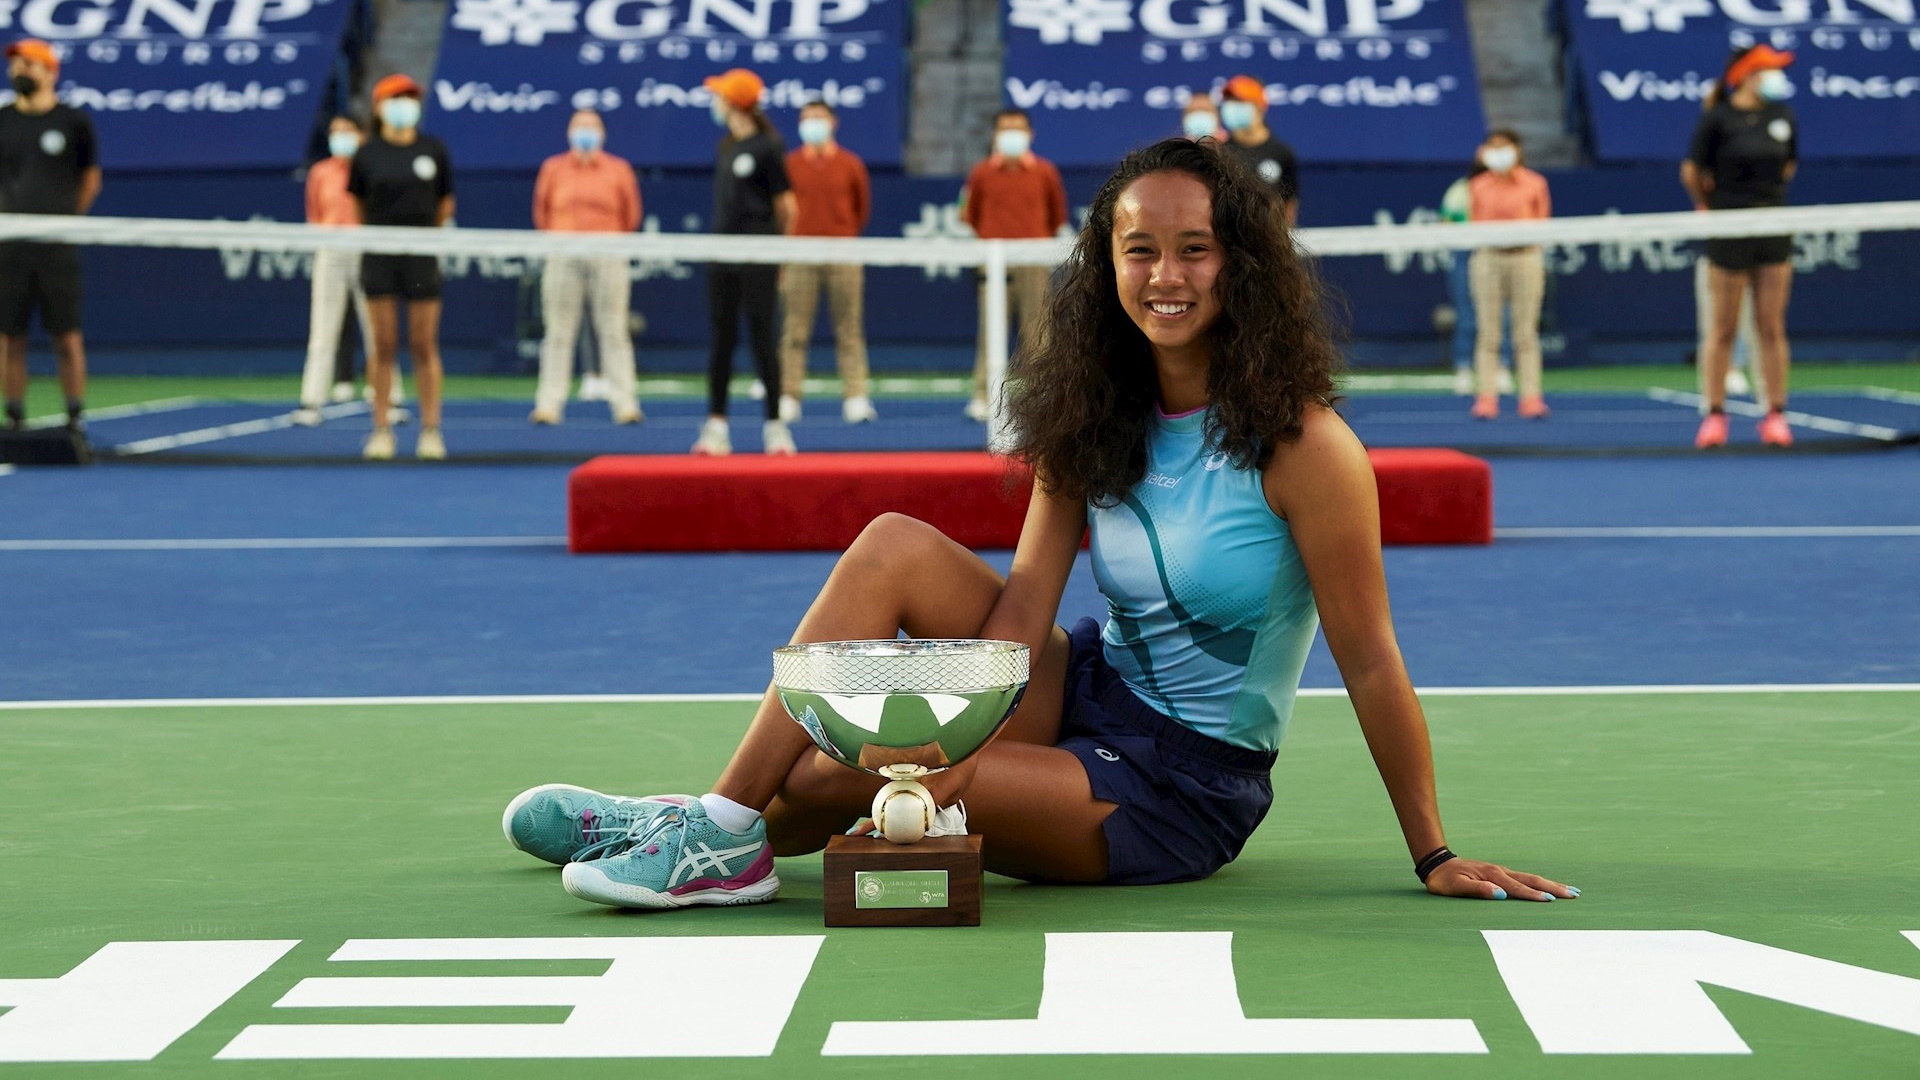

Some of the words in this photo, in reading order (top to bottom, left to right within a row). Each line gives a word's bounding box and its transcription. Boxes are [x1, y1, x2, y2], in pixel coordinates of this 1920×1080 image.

[585, 0, 869, 40] GNP
[1139, 0, 1426, 39] GNP
[577, 37, 867, 63] SEGUROS
[1141, 36, 1431, 63] SEGUROS
[435, 79, 560, 112] Vivir
[1006, 76, 1131, 110] Vivir
